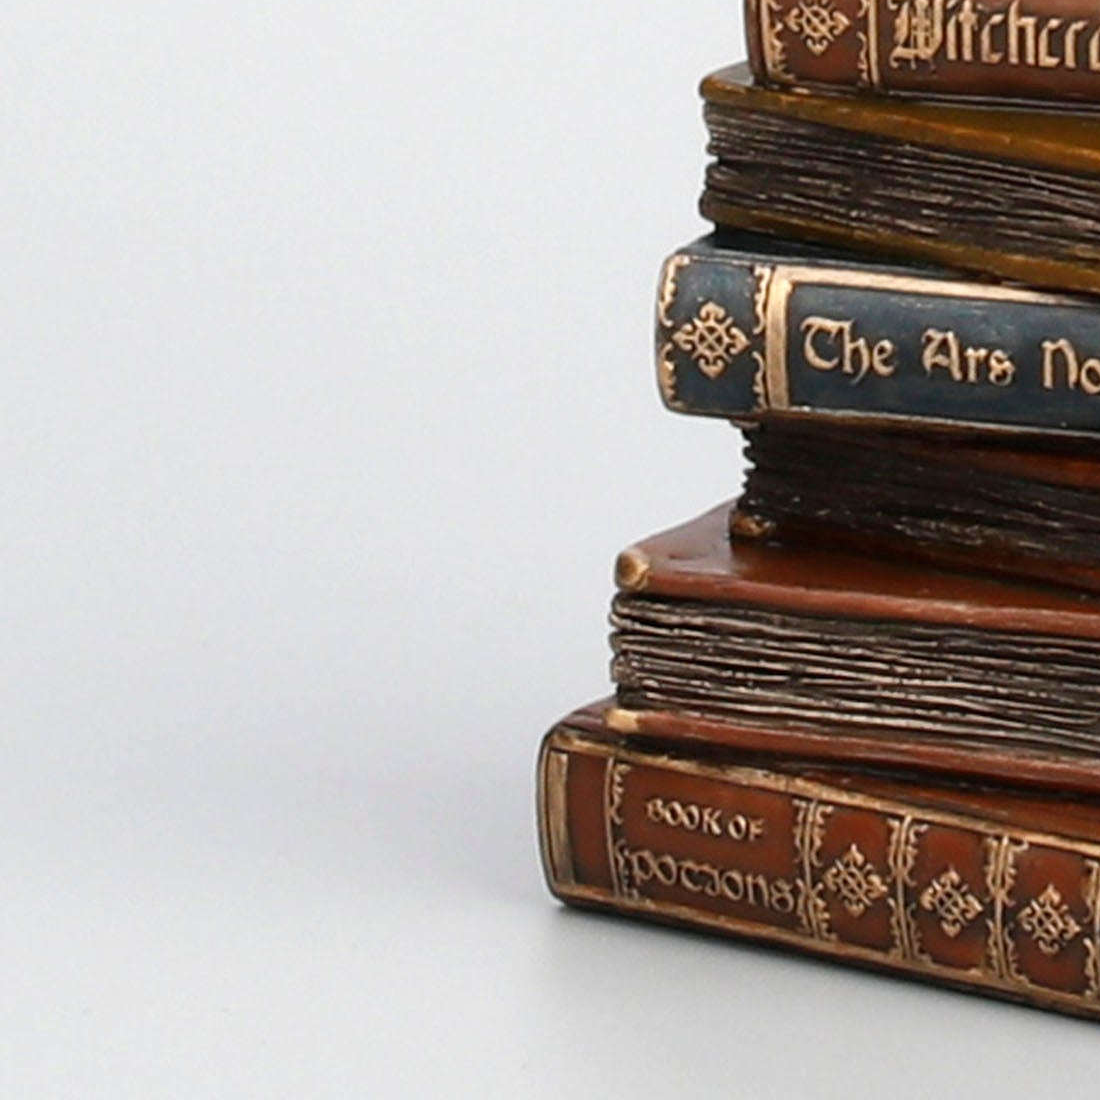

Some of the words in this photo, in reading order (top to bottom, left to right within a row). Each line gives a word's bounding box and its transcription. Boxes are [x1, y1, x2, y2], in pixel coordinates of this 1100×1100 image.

[800, 315, 896, 382] The
[922, 329, 1016, 385] Ars
[647, 798, 723, 837] BOOK
[728, 814, 765, 842] OF
